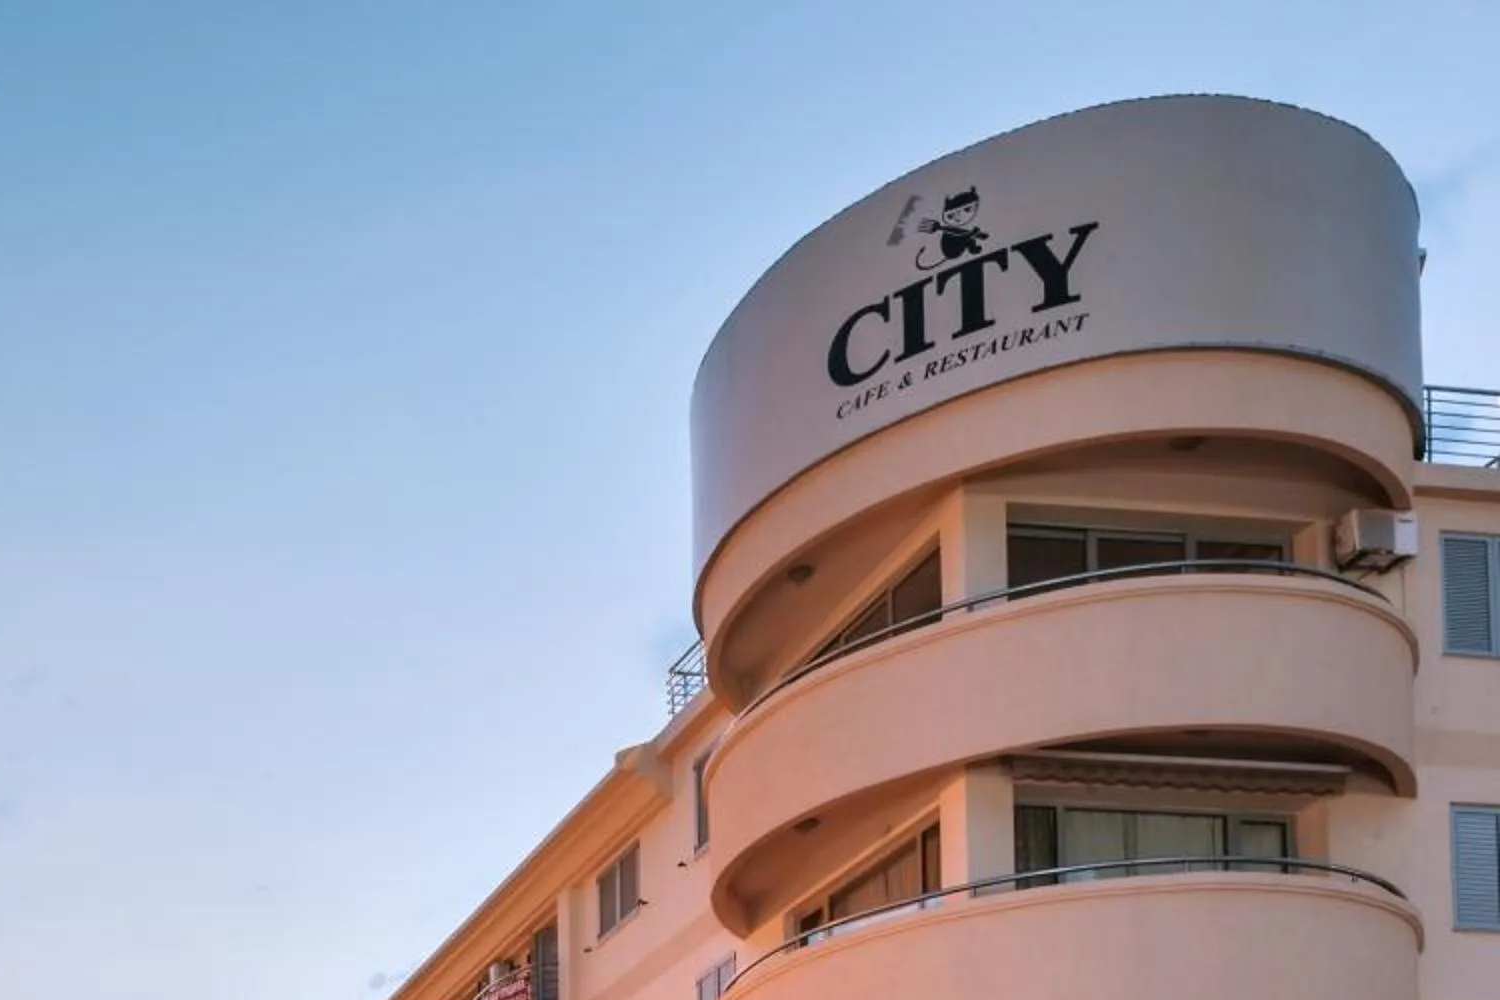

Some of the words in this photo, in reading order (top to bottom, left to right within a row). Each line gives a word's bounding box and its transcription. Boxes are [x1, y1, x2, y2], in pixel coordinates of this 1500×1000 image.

[827, 221, 1099, 386] CITY
[836, 380, 890, 419] CAFE
[897, 370, 914, 390] &
[923, 312, 1091, 380] RESTAURANT
